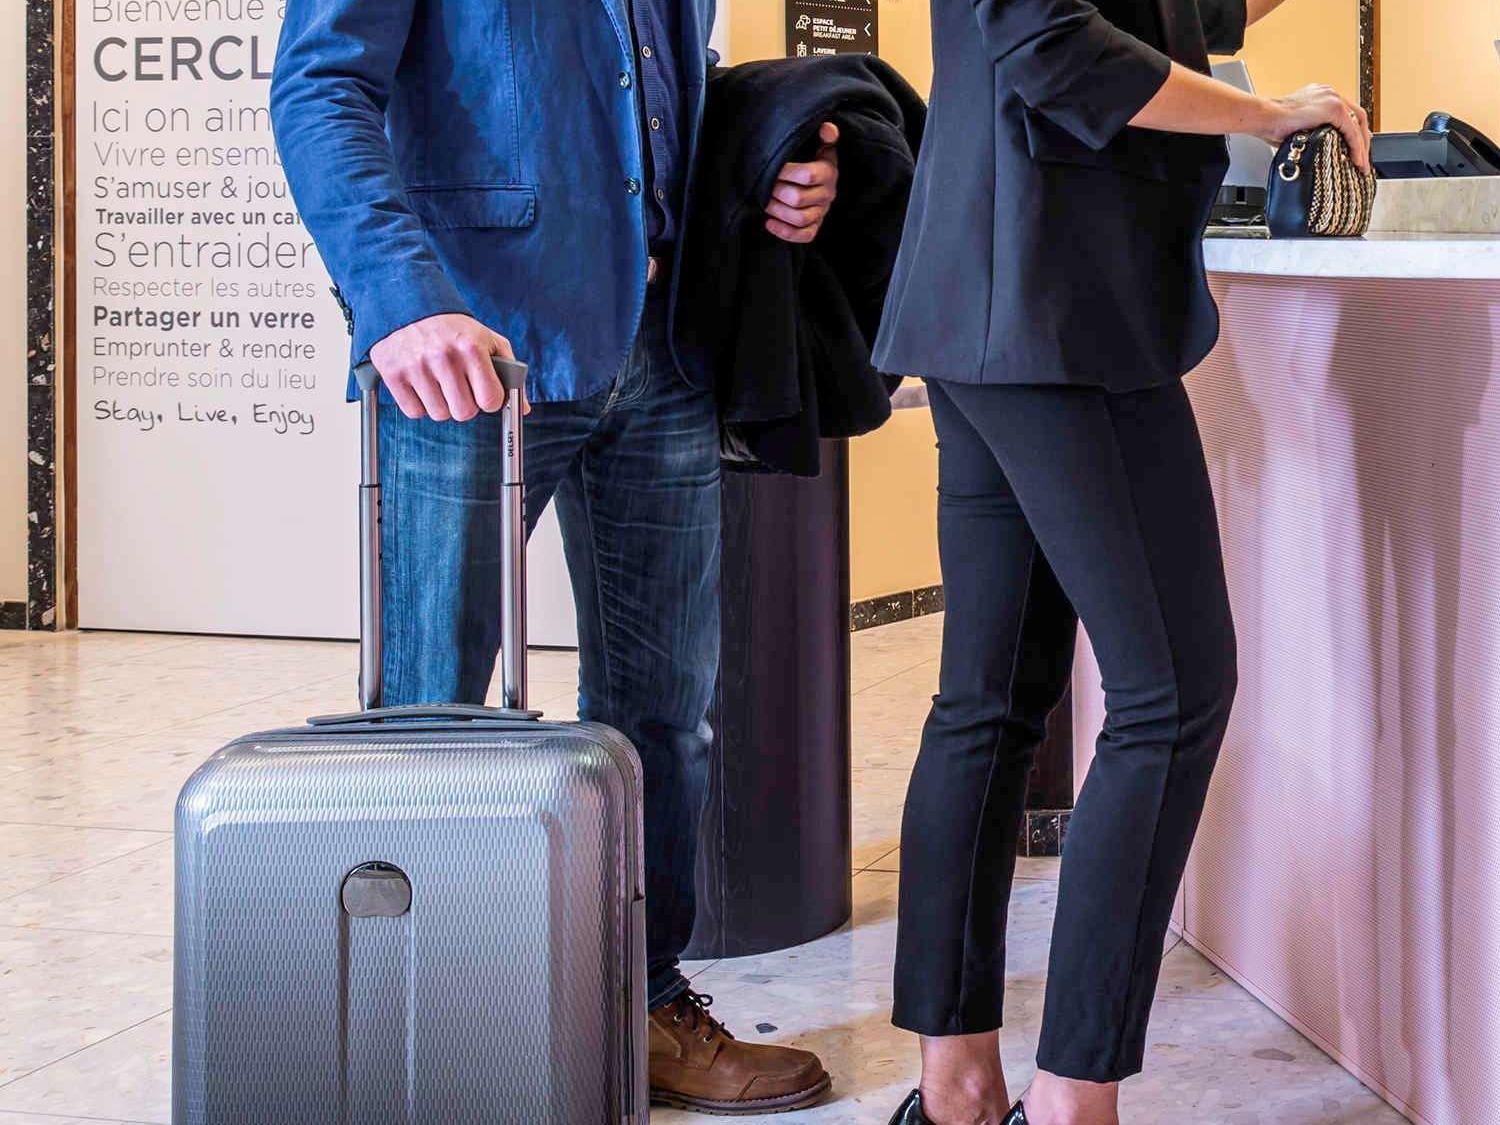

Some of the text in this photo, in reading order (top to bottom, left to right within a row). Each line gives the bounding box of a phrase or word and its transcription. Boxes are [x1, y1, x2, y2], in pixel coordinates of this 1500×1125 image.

[94, 35, 272, 82] CERCL
[93, 99, 271, 133] Ici on aim
[94, 141, 165, 166] Vivre
[94, 175, 286, 203] S'amuser & jou
[95, 207, 184, 225] Travailler
[191, 211, 235, 225] avec
[242, 211, 266, 225] un
[94, 232, 315, 269] S'entraider
[93, 276, 315, 300] Respecter les autres
[93, 305, 315, 332] Partager un verre
[93, 337, 316, 360] Emprunter & rendre
[93, 366, 316, 390] Prendre soin du lieu
[93, 400, 315, 435] Stay, Live, Enjoy
